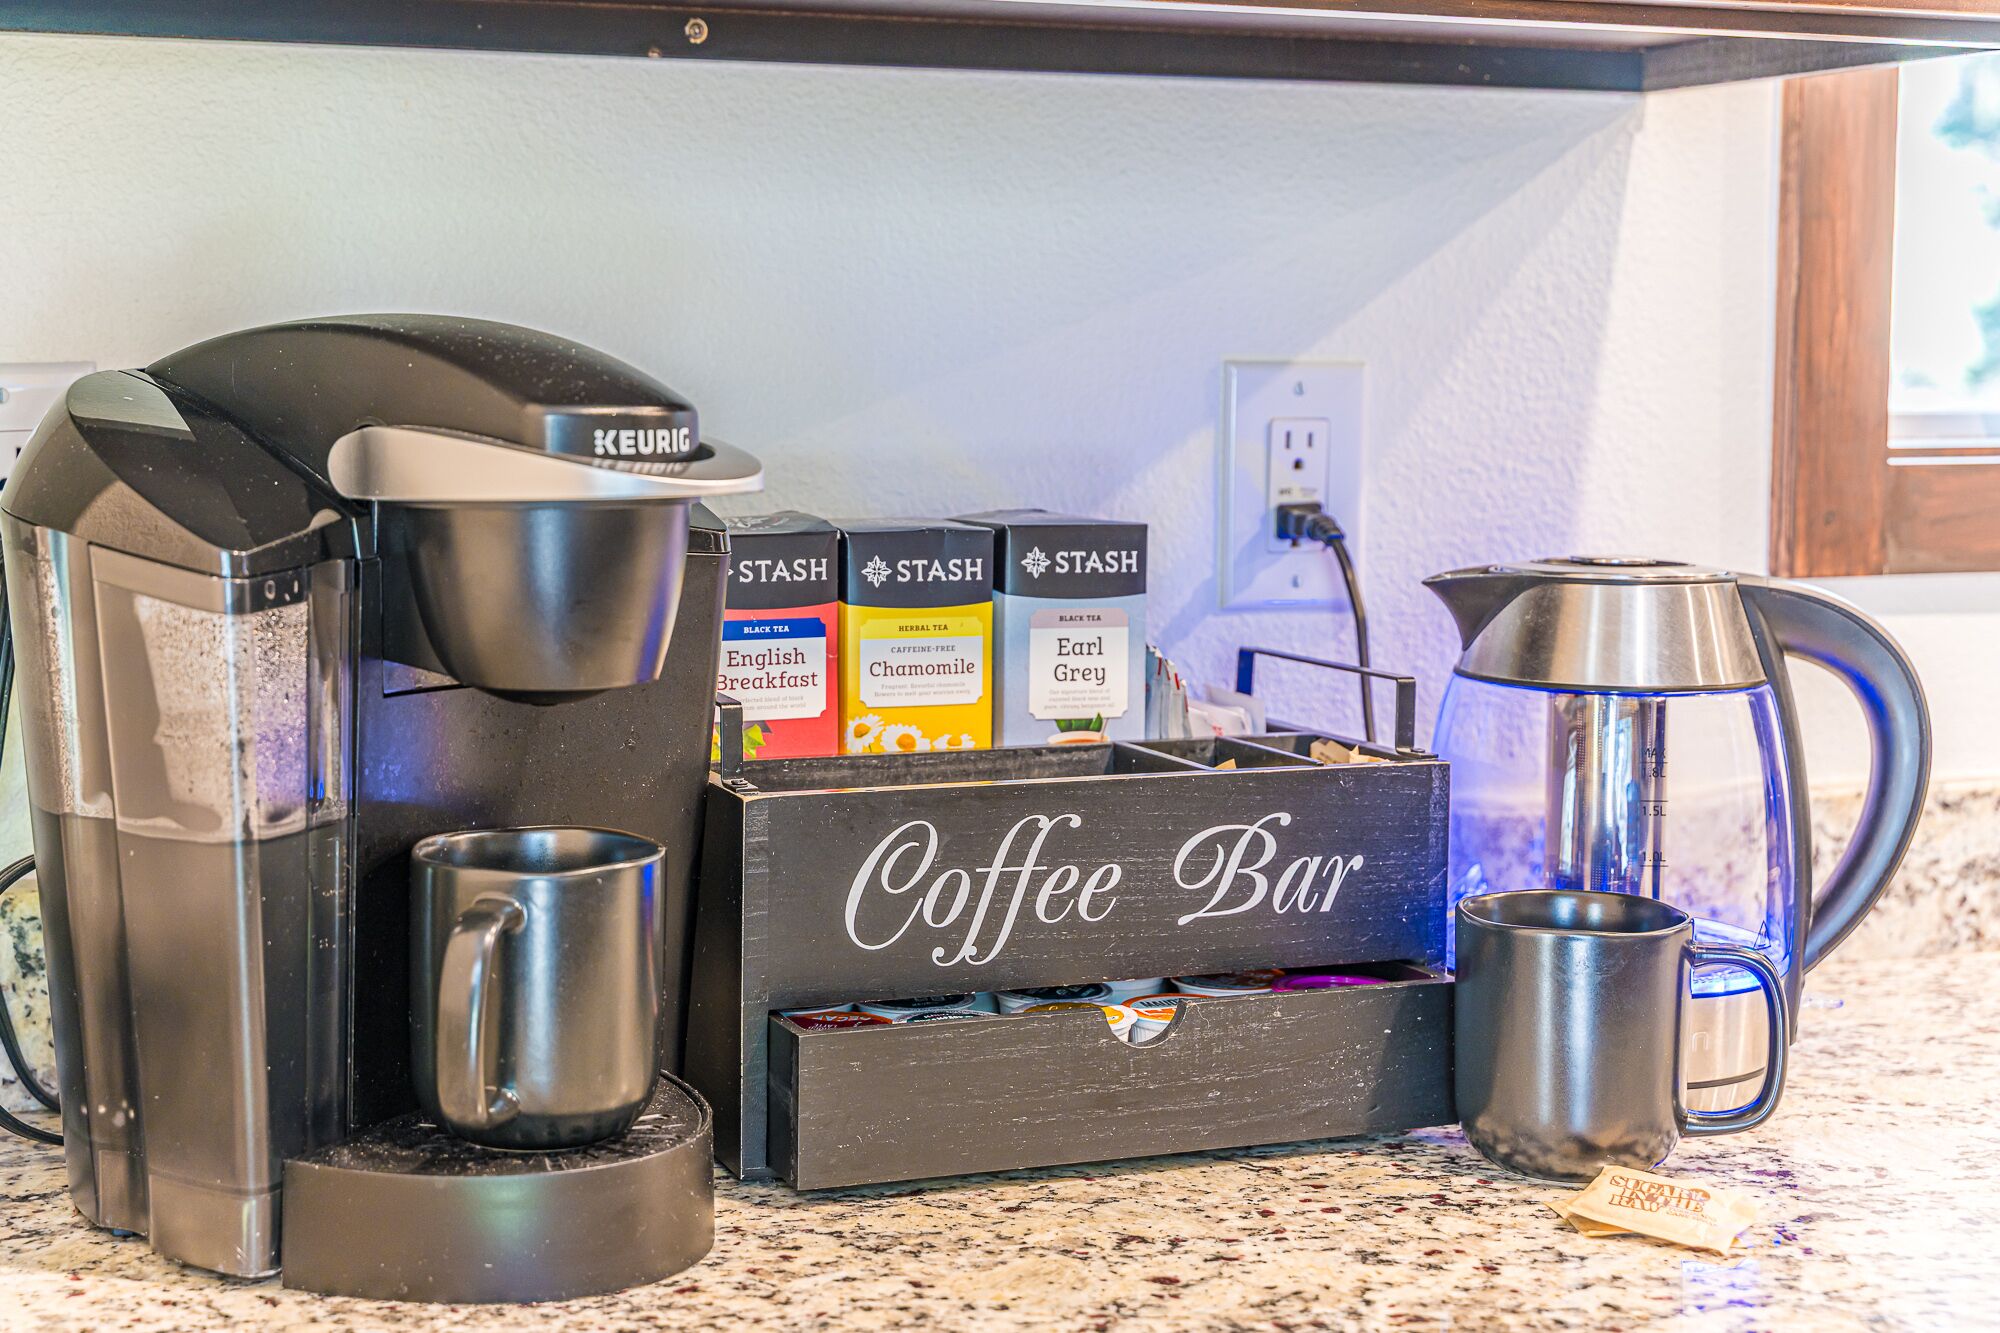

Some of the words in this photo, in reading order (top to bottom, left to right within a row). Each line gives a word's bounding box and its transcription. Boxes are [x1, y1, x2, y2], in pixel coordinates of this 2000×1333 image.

[593, 427, 690, 456] KEURIG
[739, 558, 828, 583] STASH
[896, 558, 983, 583] STASH
[1055, 550, 1139, 574] STASH
[1086, 614, 1102, 622] TEA
[743, 626, 771, 634] BLACK
[773, 625, 790, 633] TEA
[890, 645, 956, 654] CAFFEINE-FREE
[1057, 636, 1104, 656] Earl
[726, 647, 807, 671] English
[869, 658, 975, 677] Chamomile
[717, 671, 819, 691] Breakfast
[1054, 663, 1106, 686] Grey
[1641, 766, 1666, 778] 1.8L
[1641, 805, 1667, 817] 1.5L
[1641, 850, 1666, 862] 1.0L
[844, 813, 1124, 967] Coffee
[1172, 811, 1363, 926] Bar
[1609, 1174, 1693, 1200] SUGAR
